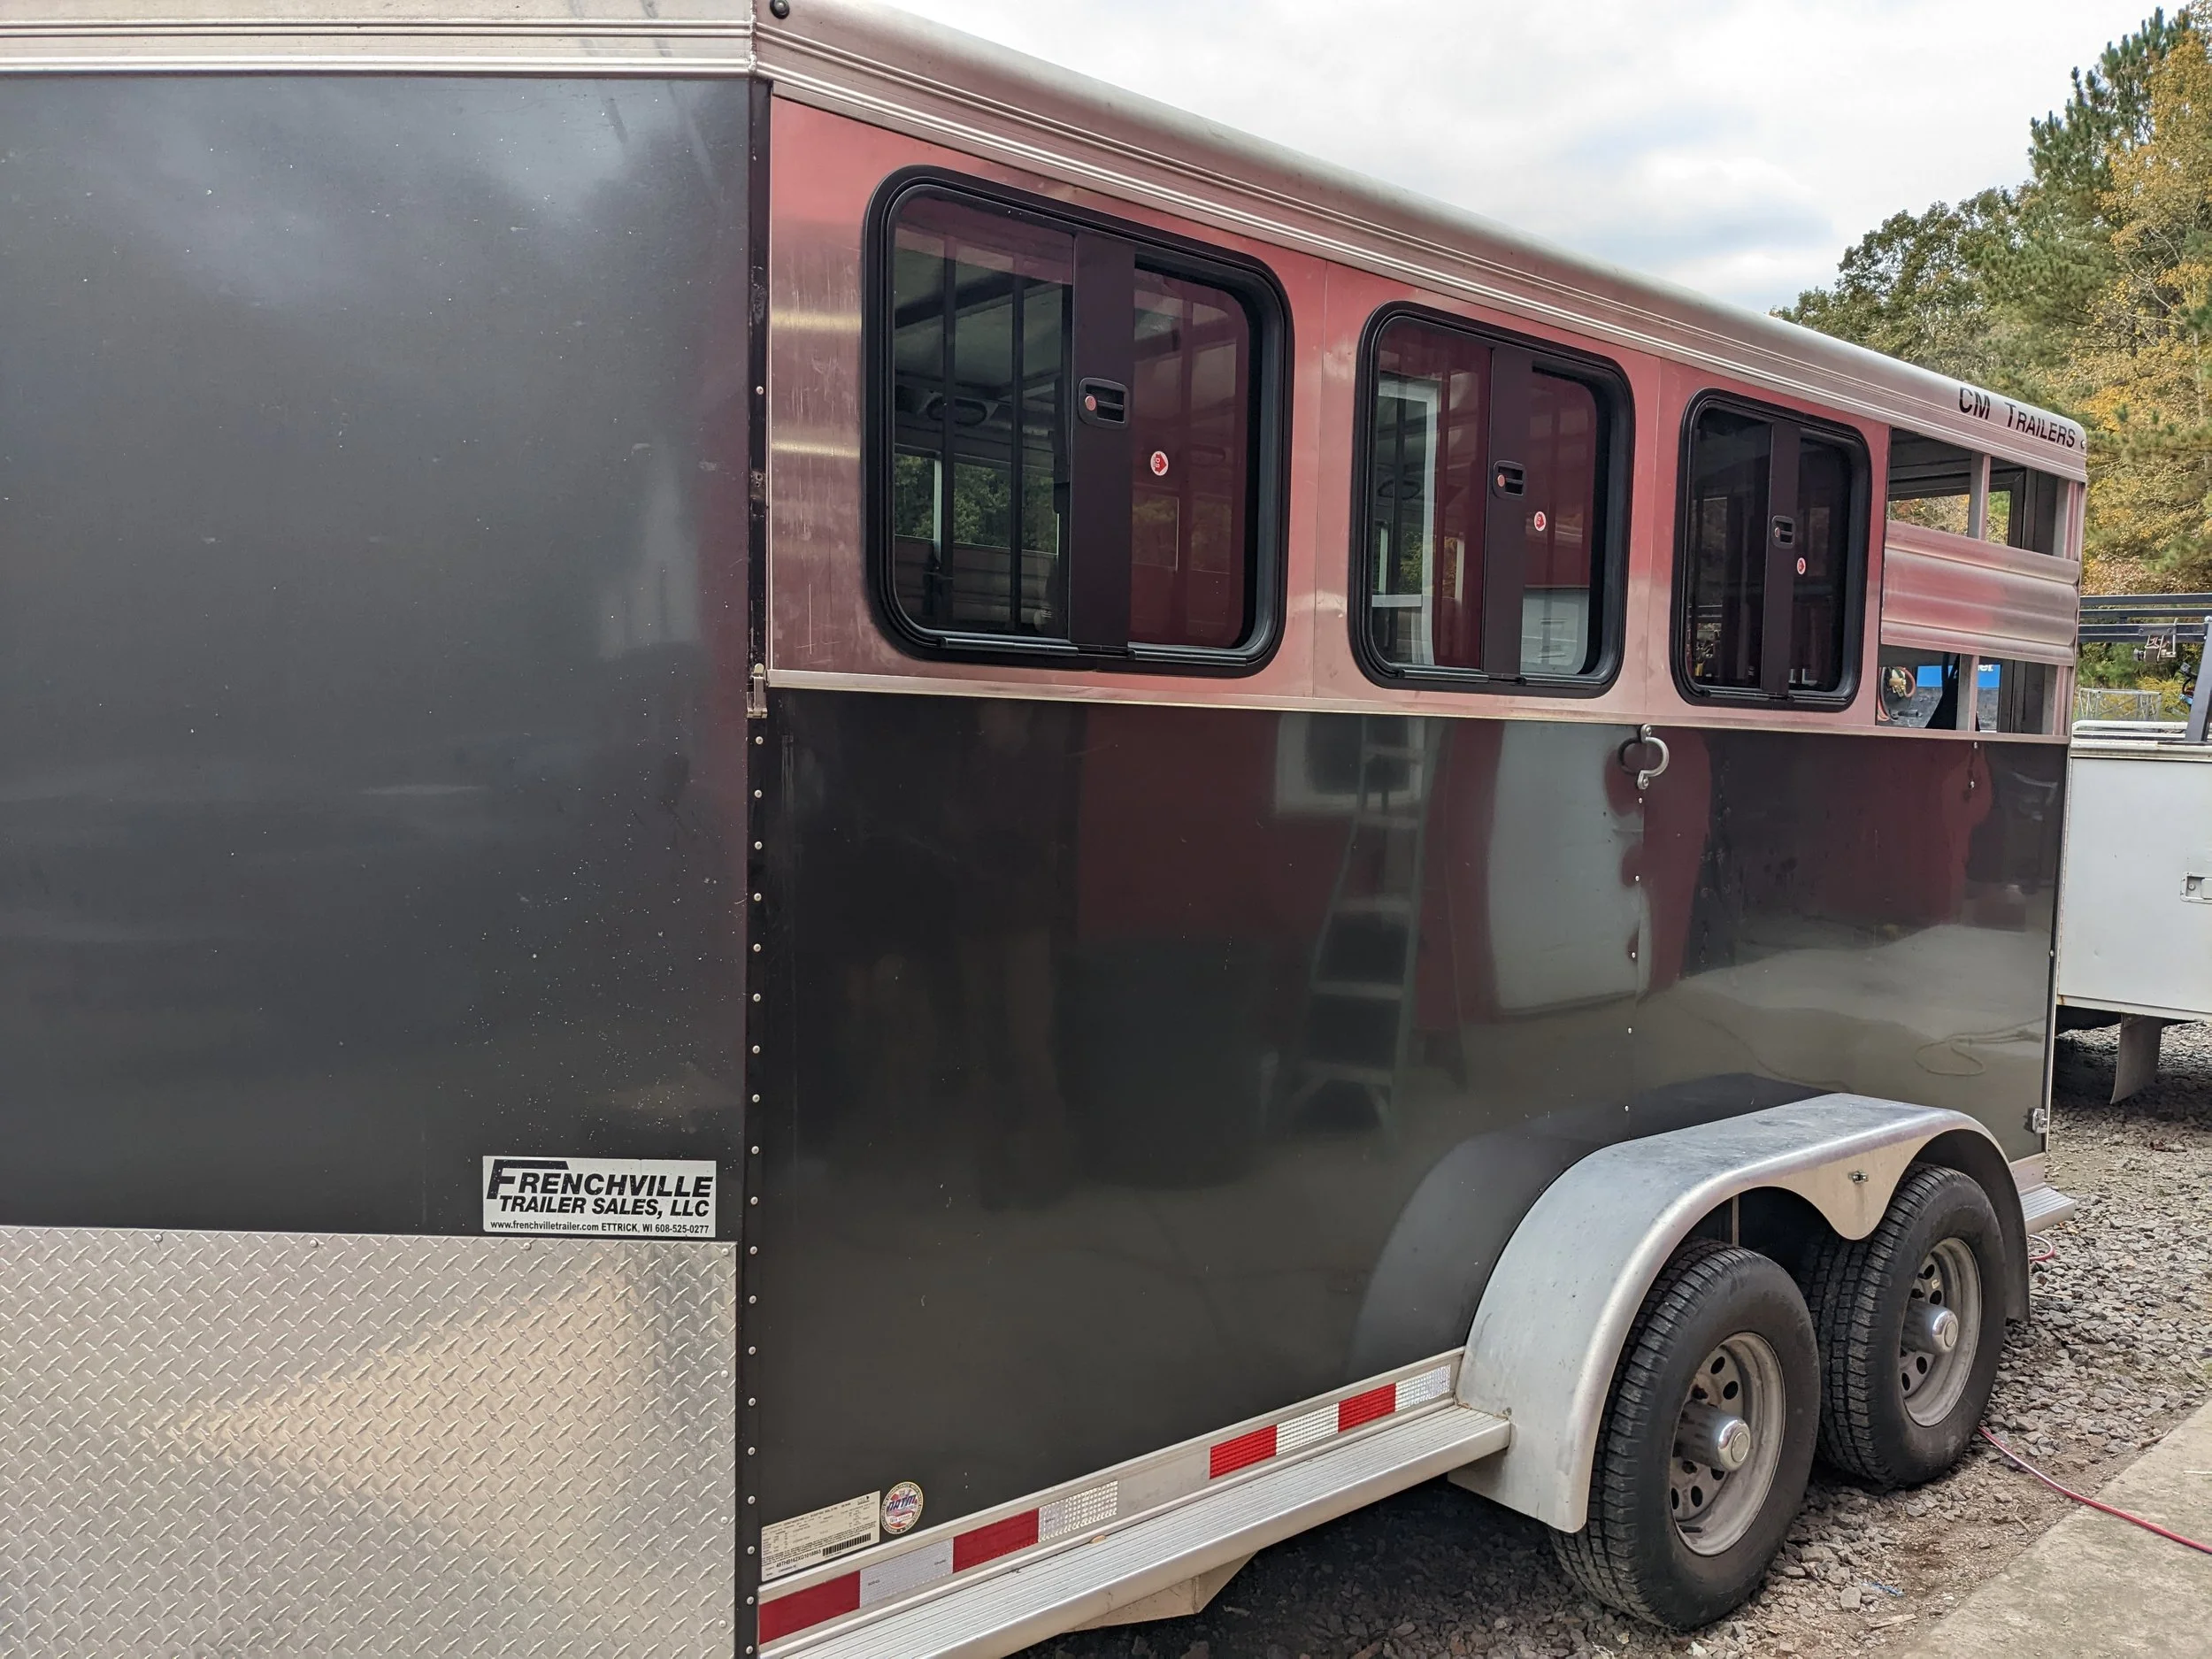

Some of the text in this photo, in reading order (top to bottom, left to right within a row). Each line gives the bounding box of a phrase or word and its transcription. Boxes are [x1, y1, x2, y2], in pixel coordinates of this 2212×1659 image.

[1959, 387, 2076, 448] CM TRAILERS
[487, 1159, 713, 1199] FRENCHVILLE
[500, 1195, 710, 1219] TRAILER SALES, LLC
[490, 1220, 709, 1233] www.frenchvilletrailer.com ETTRICK, WI 608-525-0277
